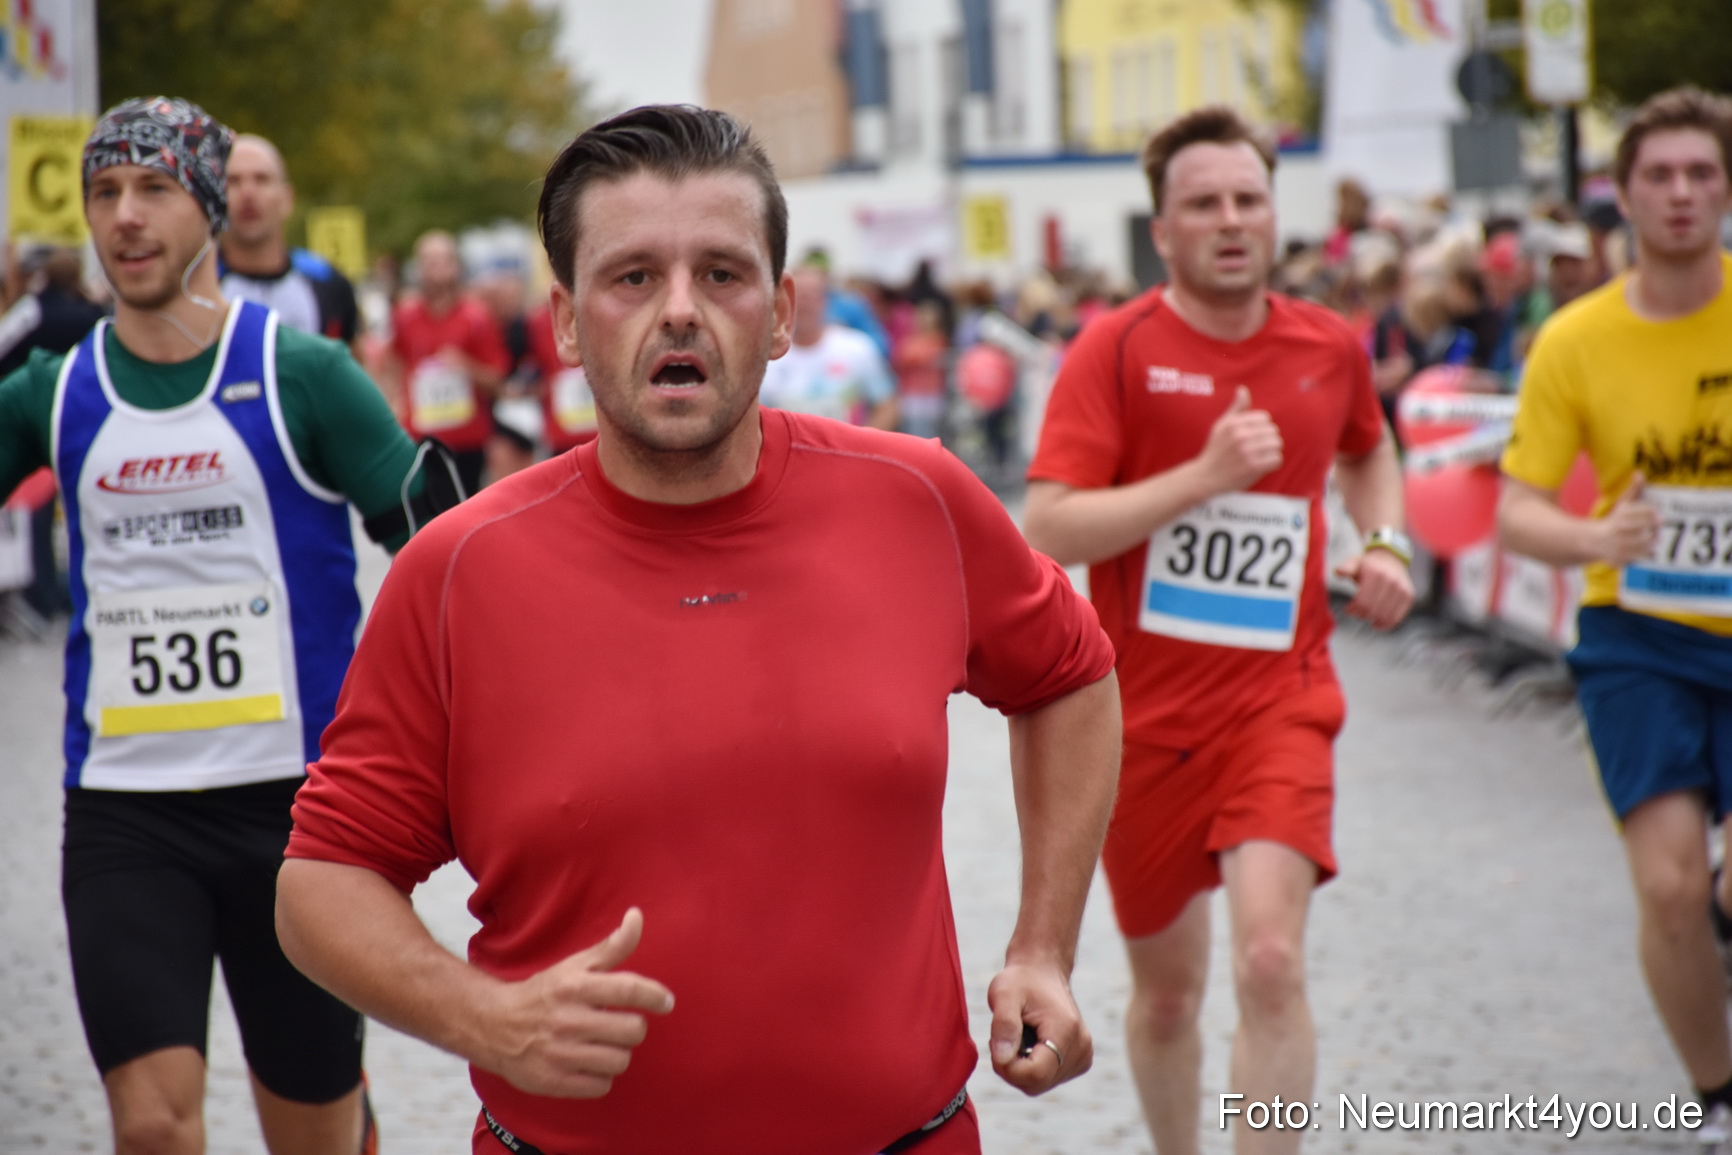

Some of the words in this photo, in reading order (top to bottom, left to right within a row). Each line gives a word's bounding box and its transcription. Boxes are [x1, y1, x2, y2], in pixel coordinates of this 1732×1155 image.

[28, 152, 69, 215] C
[119, 450, 223, 479] ERTEL
[1167, 523, 1294, 591] 3022
[97, 609, 147, 626] PARTL
[153, 603, 241, 623] Neumarkt
[131, 628, 242, 696] 536
